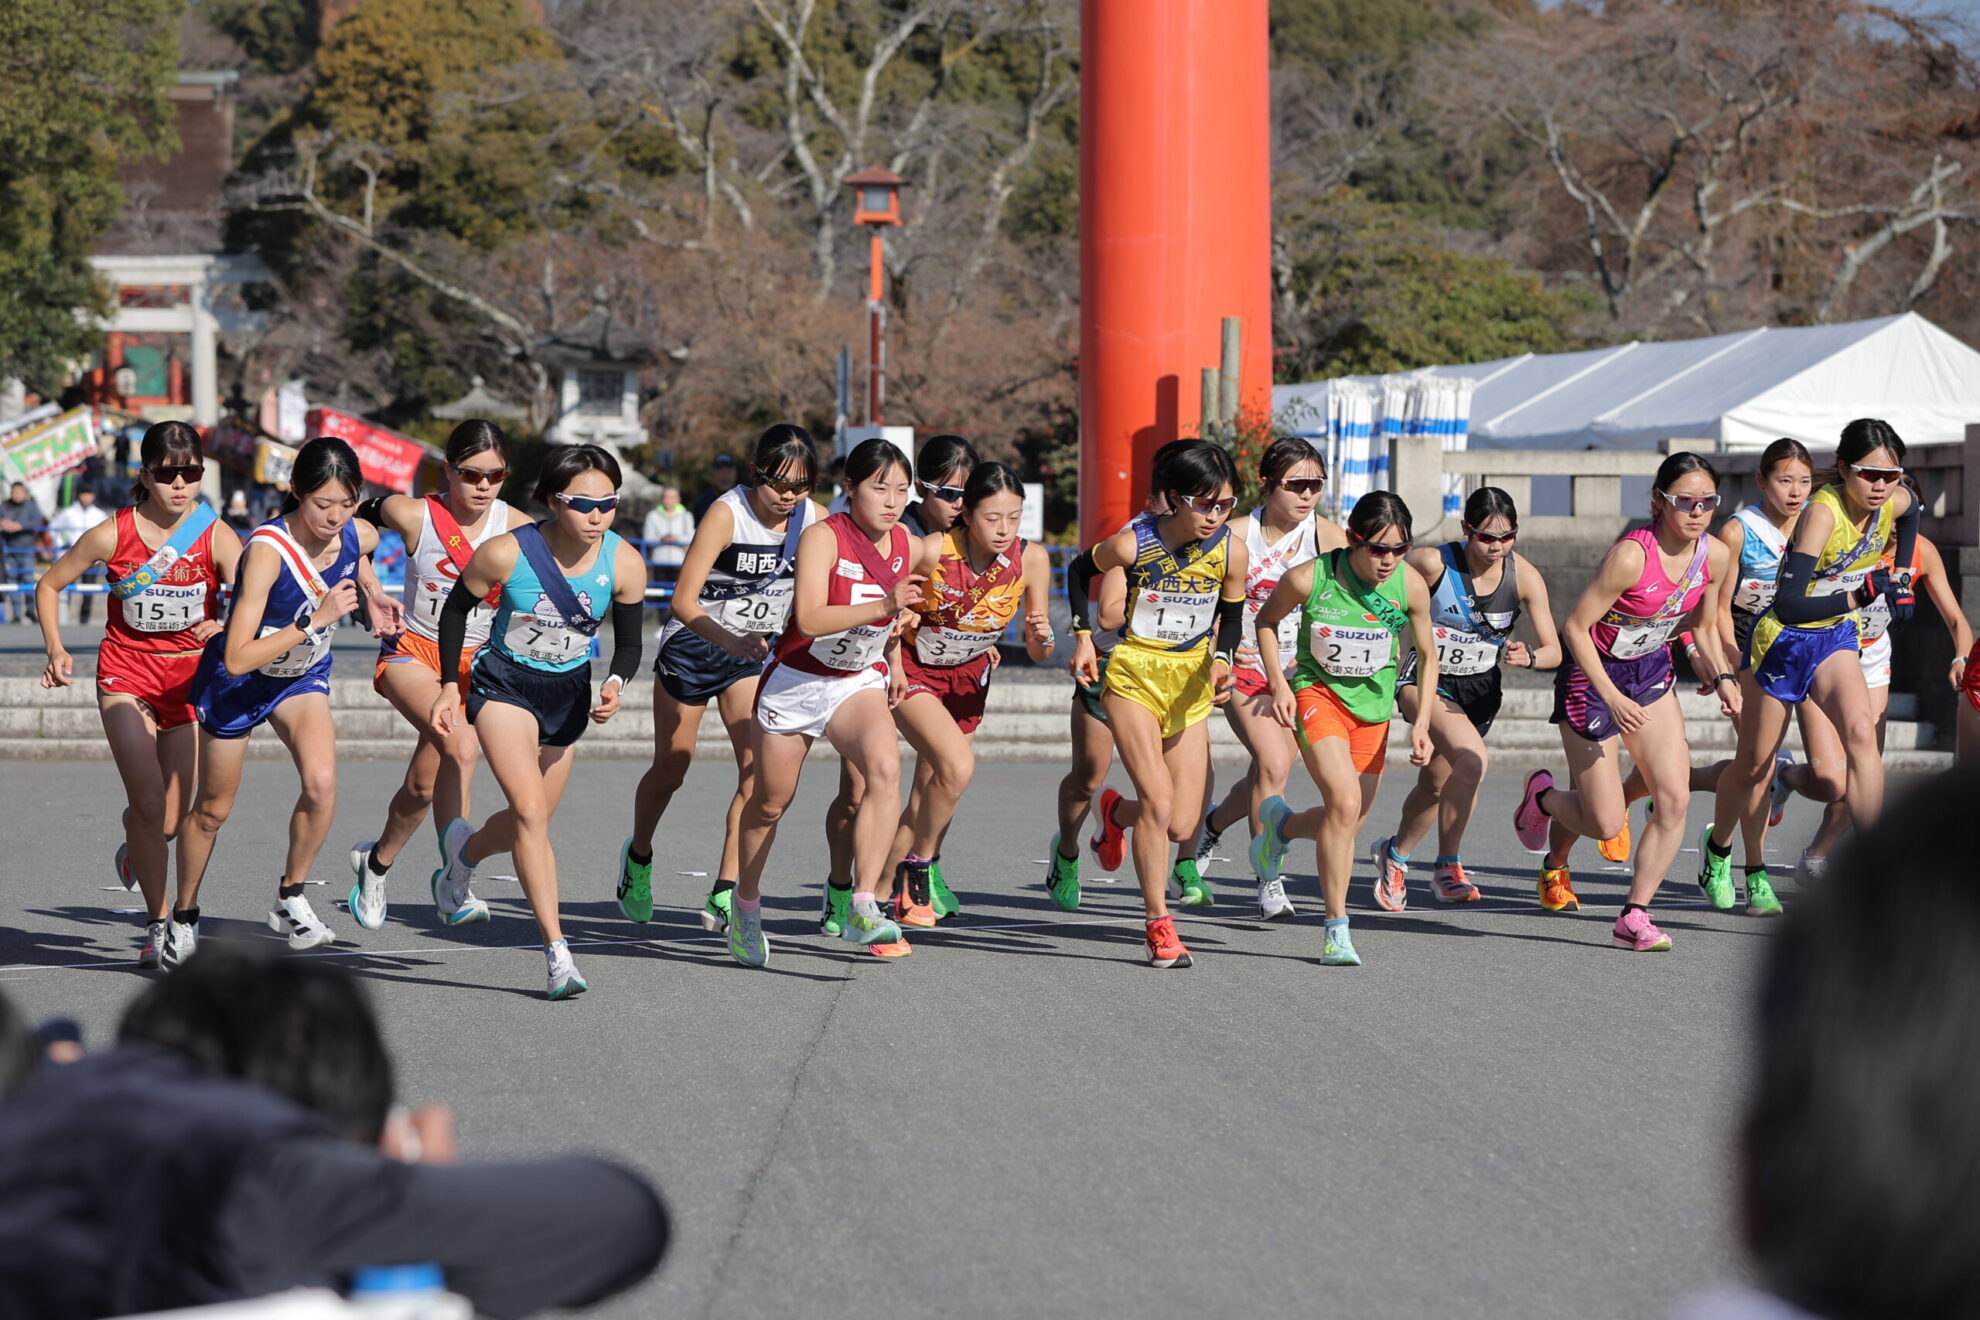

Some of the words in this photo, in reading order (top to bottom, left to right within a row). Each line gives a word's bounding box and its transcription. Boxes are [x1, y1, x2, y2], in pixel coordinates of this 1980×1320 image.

[145, 588, 200, 598] SUZUKI
[1162, 596, 1215, 606] SUZUKI
[134, 602, 189, 620] 15-1
[1156, 607, 1196, 629] 1-1
[745, 620, 775, 630] 関西大
[526, 627, 571, 650] 7-1
[1157, 629, 1190, 640] 城西大
[1335, 630, 1389, 641] SUZUKI
[930, 640, 974, 656] 3-1
[1326, 644, 1370, 663] 2-1
[1437, 645, 1484, 665] 18-1
[1322, 663, 1376, 676] 大東文化大
